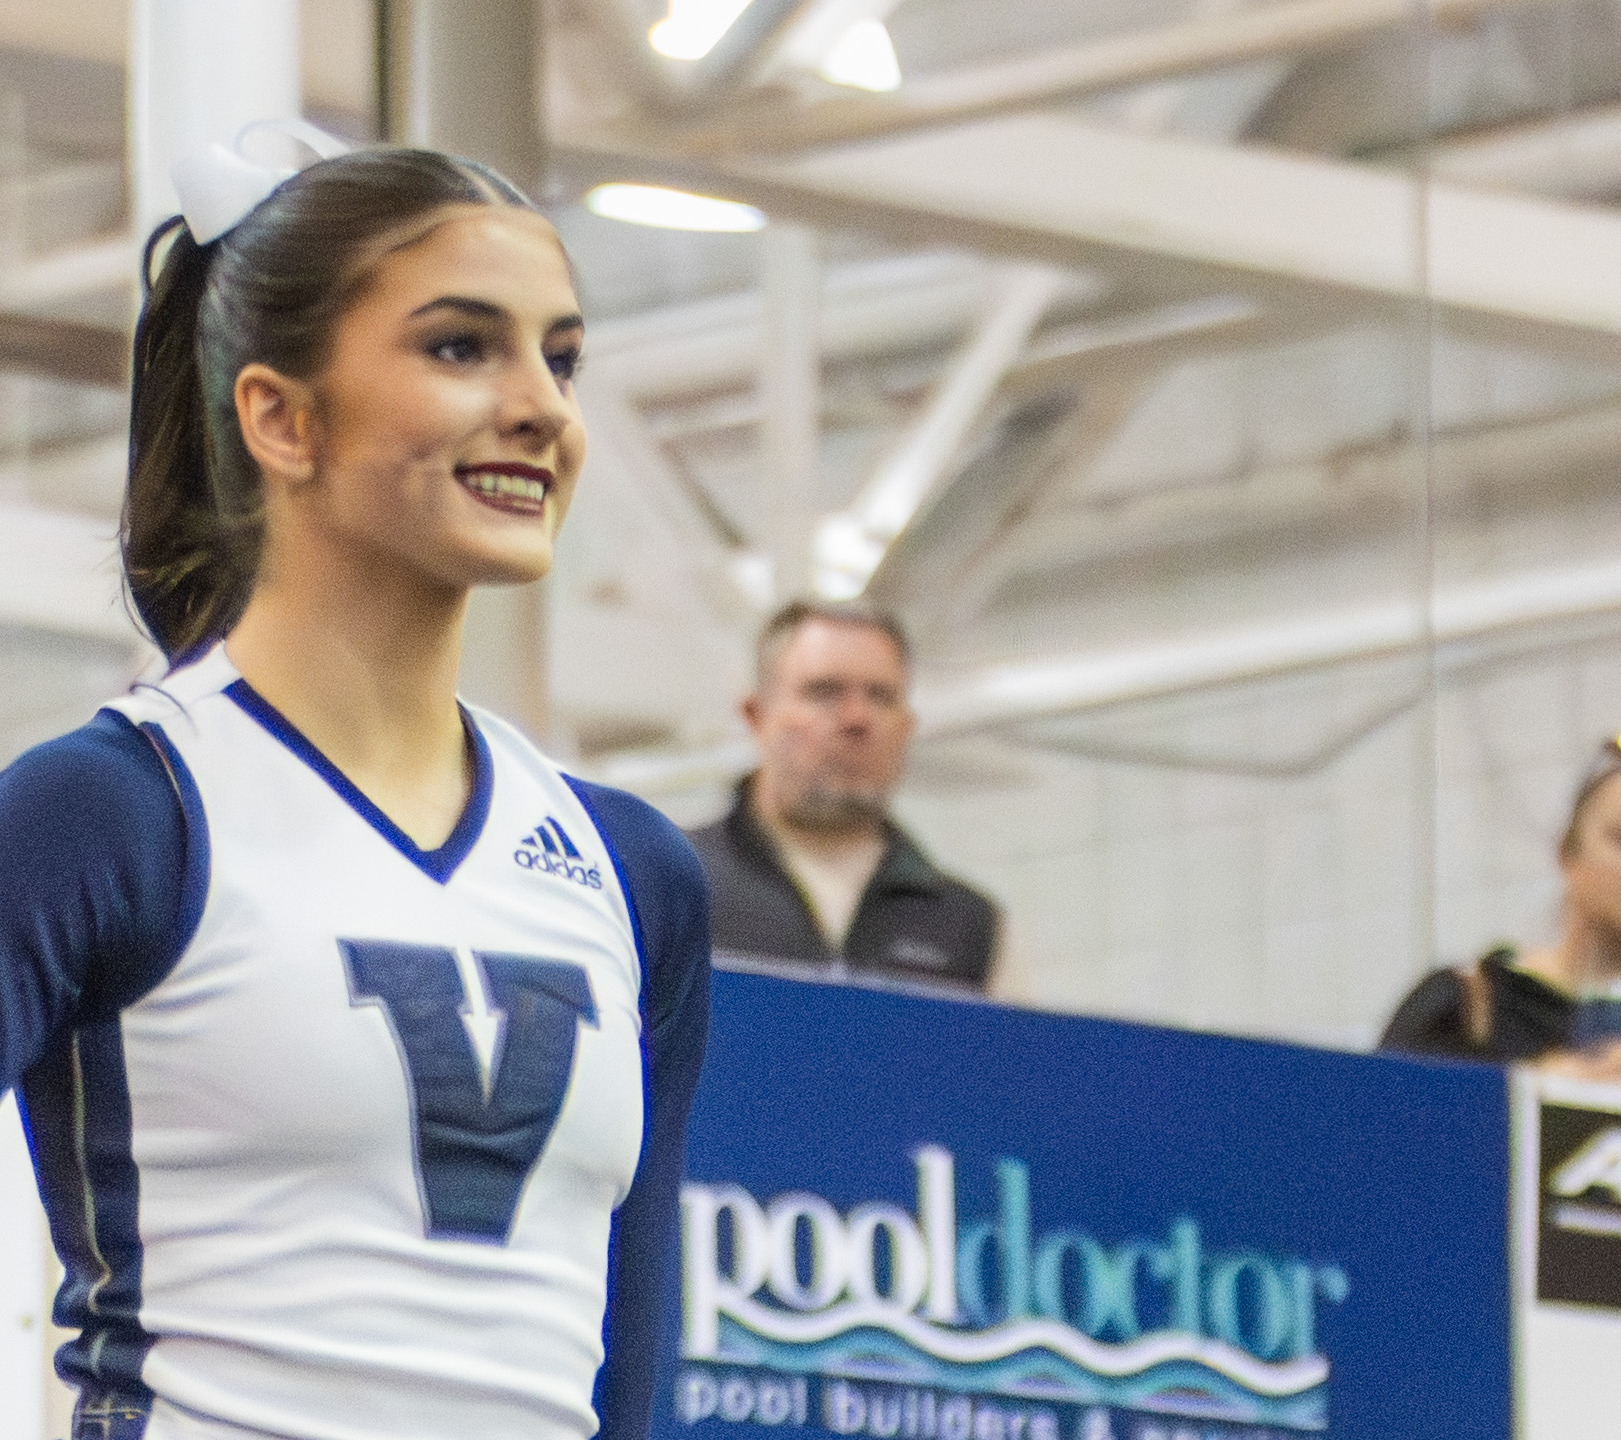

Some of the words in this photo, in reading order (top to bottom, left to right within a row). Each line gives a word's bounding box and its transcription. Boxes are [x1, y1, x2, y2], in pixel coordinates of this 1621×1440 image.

[513, 850, 603, 891] adidas
[336, 937, 600, 1246] V
[679, 1141, 1349, 1362] pooldoctor
[675, 1366, 809, 1426] pool
